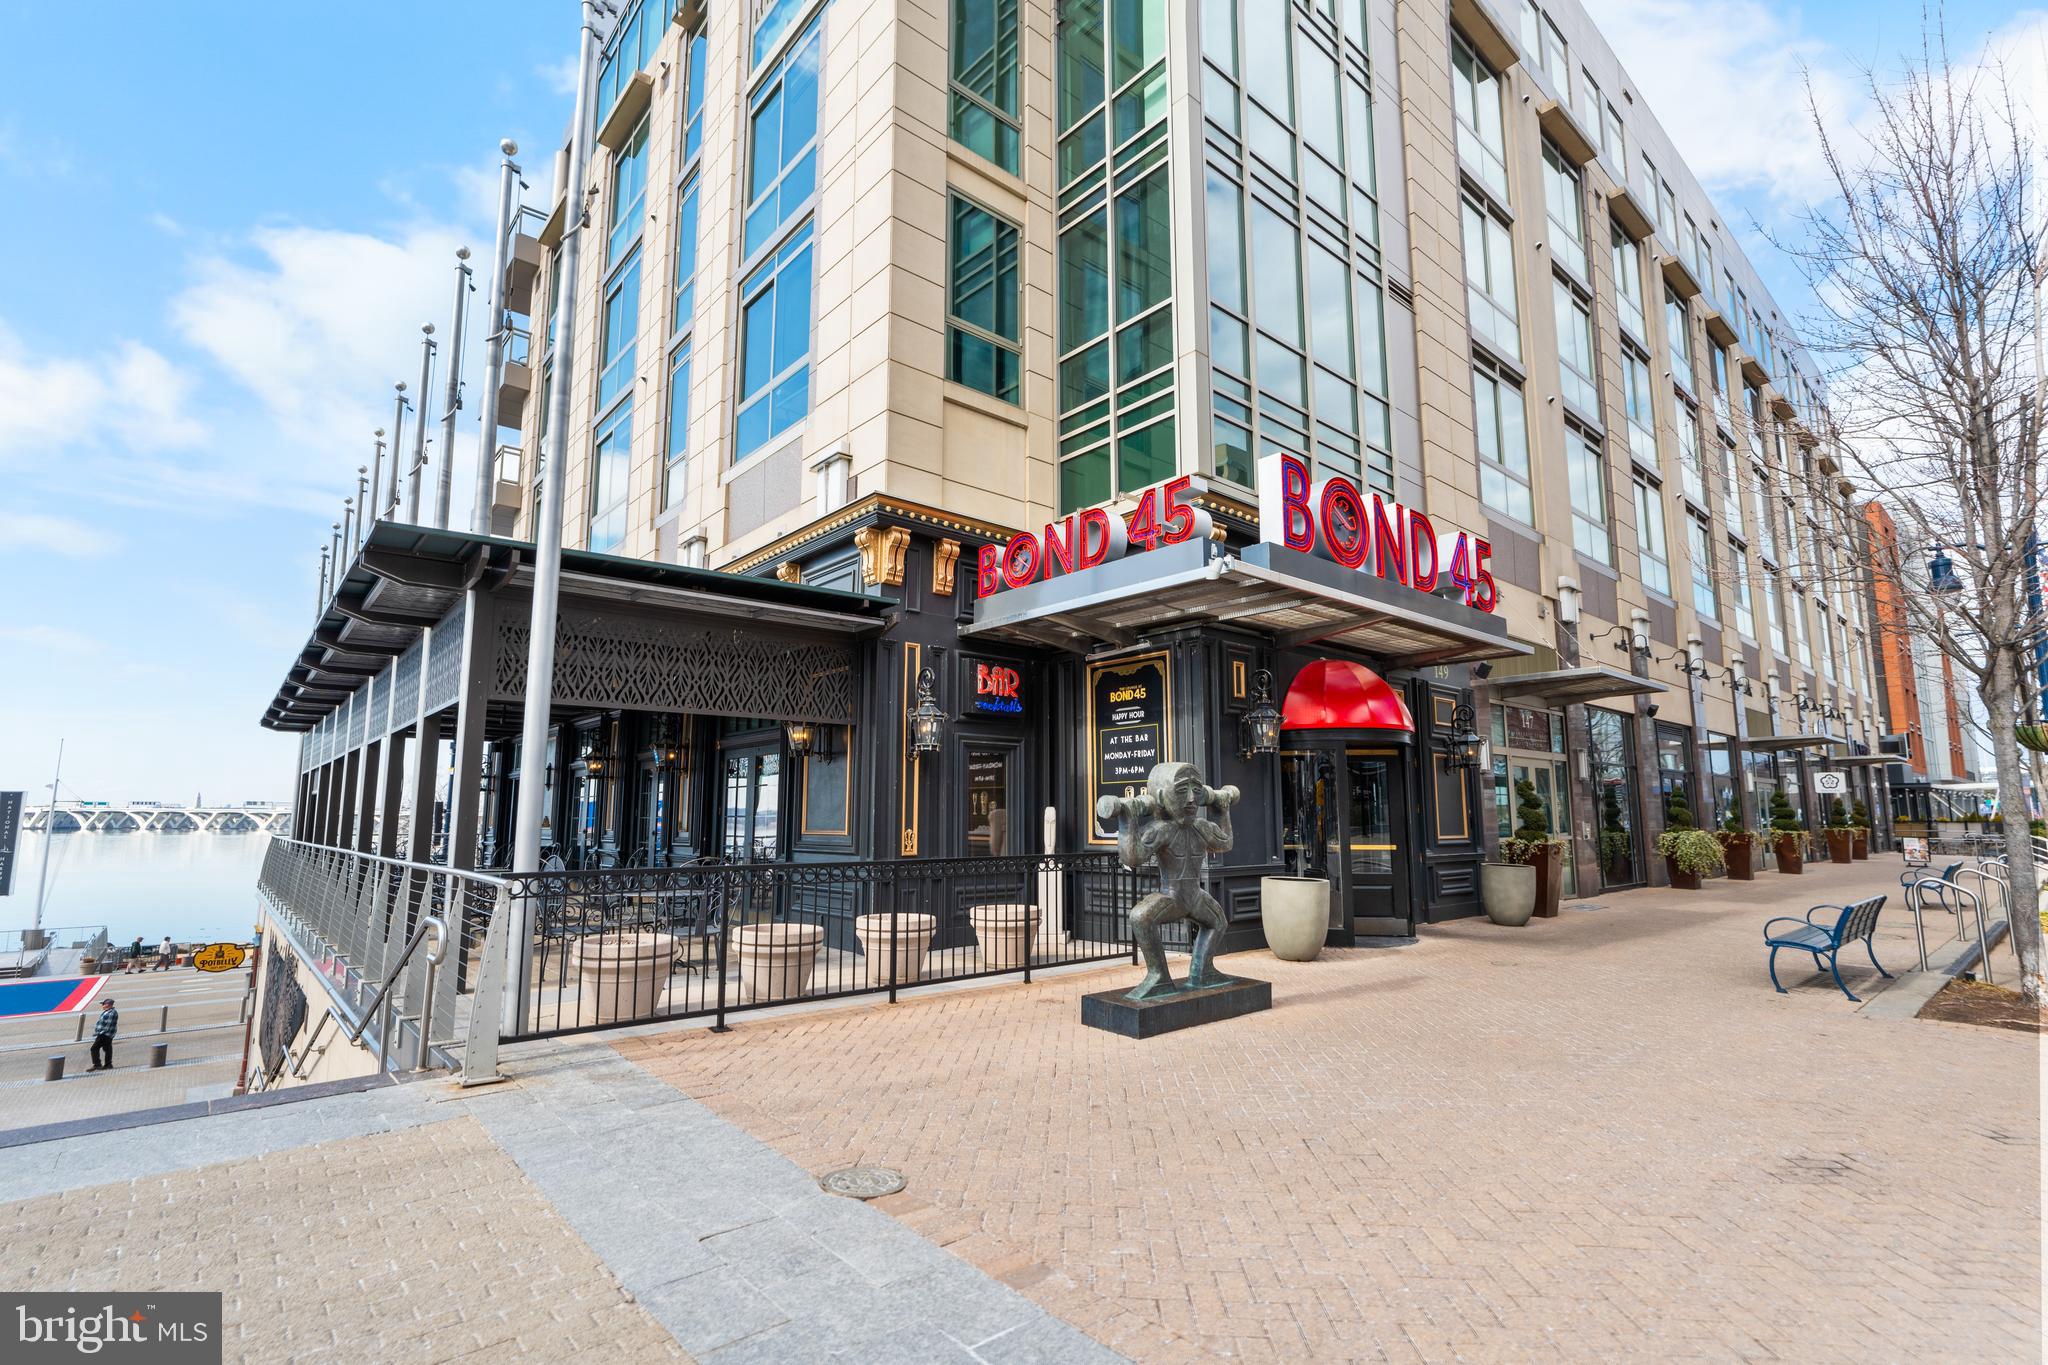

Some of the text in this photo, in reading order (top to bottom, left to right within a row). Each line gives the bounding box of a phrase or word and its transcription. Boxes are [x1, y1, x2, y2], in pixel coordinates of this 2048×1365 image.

[978, 475, 1196, 599] BOND 45
[1281, 453, 1497, 613] BOND 45
[1434, 665, 1449, 680] 149
[977, 662, 1019, 698] BAR
[1110, 688, 1146, 702] BOND 45
[1112, 710, 1145, 721] HAPPY HOUR
[1522, 713, 1534, 729] 147
[1110, 733, 1148, 745] AT THE BAR
[1104, 749, 1155, 760] MONDAY-FRIDAY
[1114, 766, 1145, 775] 3PM-6PM
[4, 800, 13, 840] NATIONAL
[200, 957, 238, 969] POTBELLY
